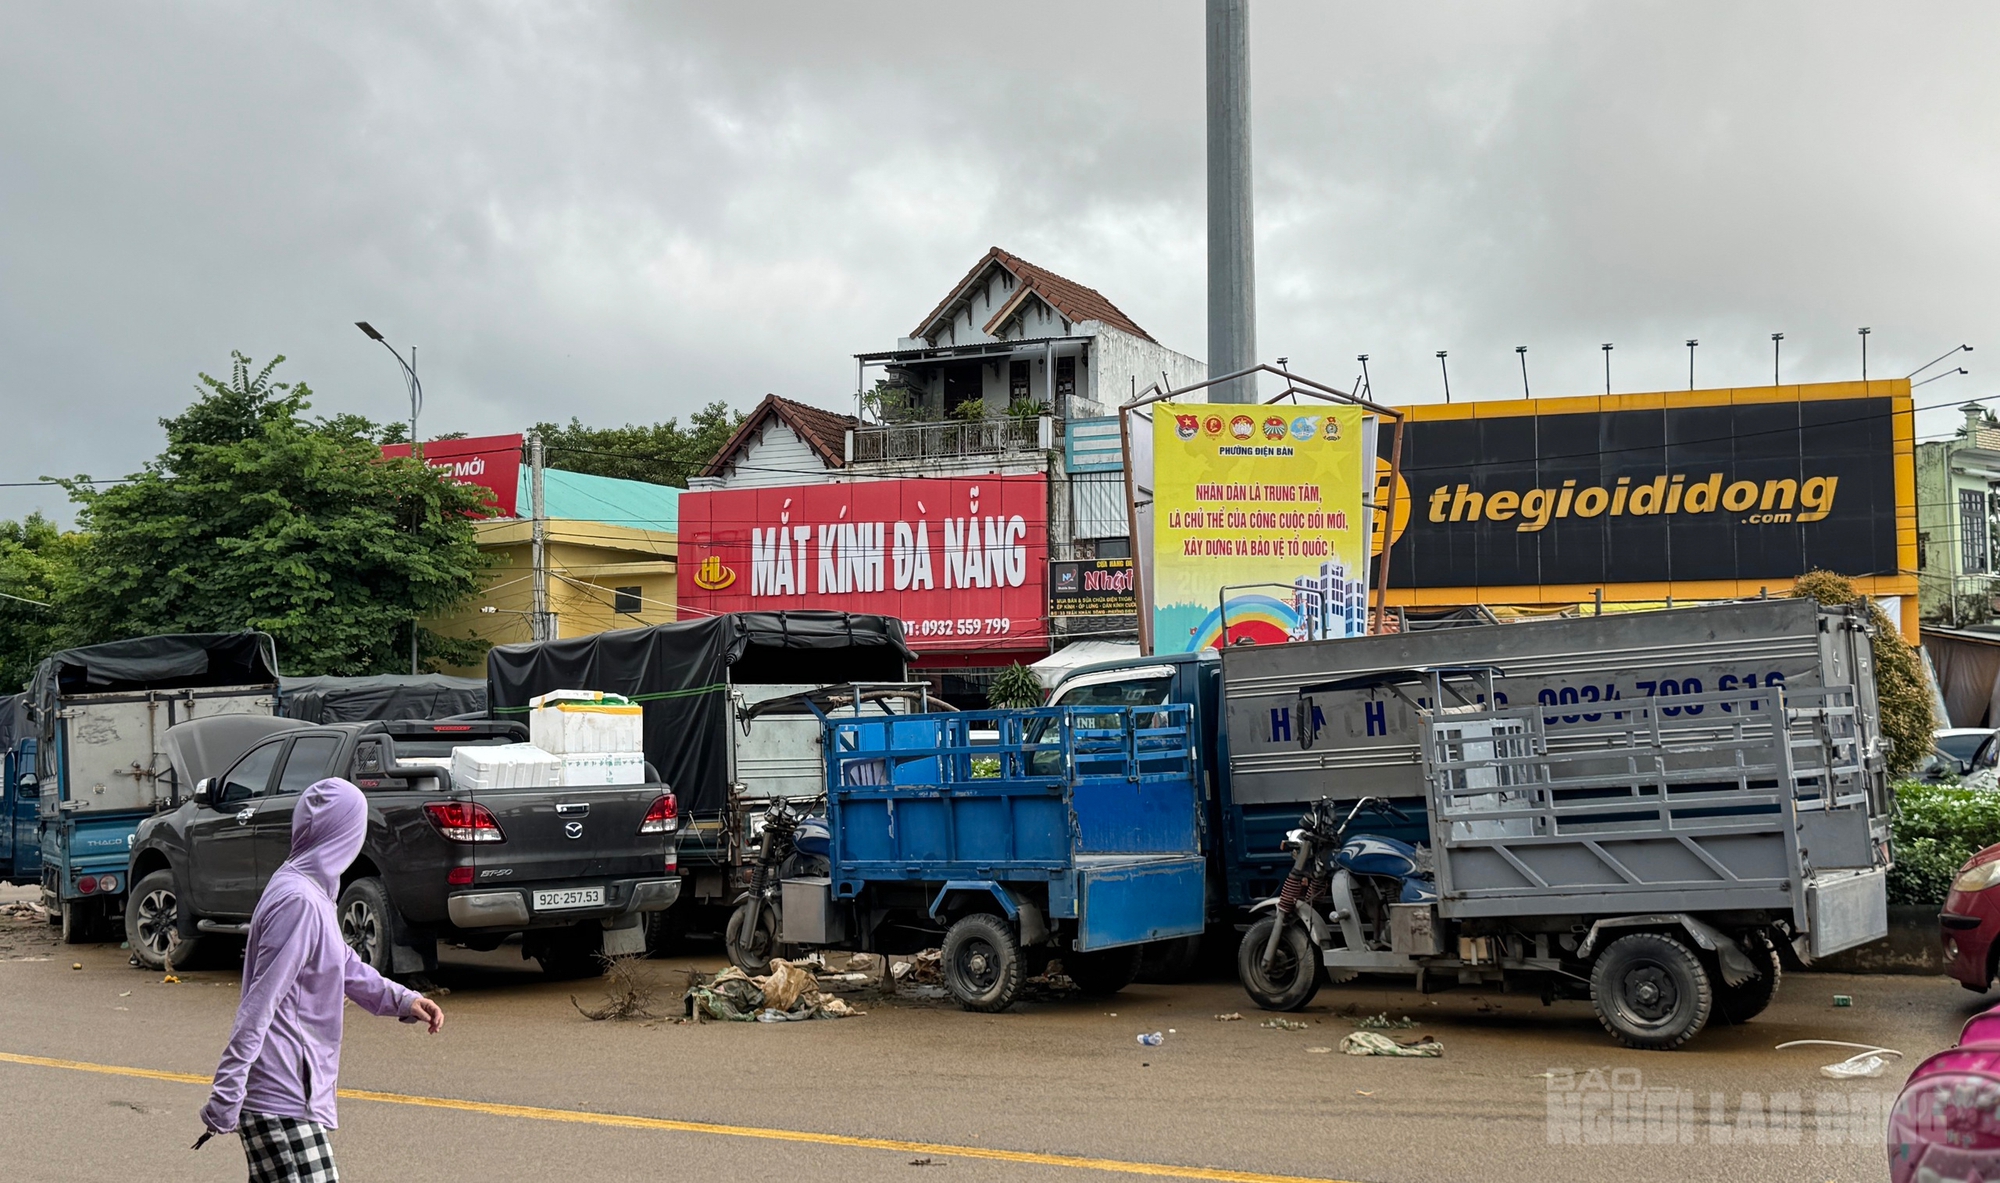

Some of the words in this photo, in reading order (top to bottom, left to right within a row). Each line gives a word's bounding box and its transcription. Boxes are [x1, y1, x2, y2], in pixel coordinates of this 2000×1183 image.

[1219, 445, 1253, 456] PHƯỜNG
[1255, 446, 1274, 457] ĐIỆN
[455, 456, 485, 477] MỚI
[1196, 482, 1224, 501] NHÂN
[1226, 482, 1247, 501] DÂN
[1249, 482, 1261, 501] LÀ
[1264, 484, 1296, 502] TRUNG
[1298, 483, 1323, 503] TÂM,
[1428, 473, 1838, 532] thegioididong
[1169, 509, 1181, 528] LÀ
[1184, 507, 1204, 528] CHỦ
[1206, 506, 1225, 528] THỂ
[1227, 507, 1247, 529] CỦA
[1249, 509, 1276, 529] CÔNG
[1279, 509, 1305, 532] CUỘC
[1307, 506, 1324, 529] ĐỔI
[1326, 509, 1349, 531] MỚI,
[1741, 513, 1792, 525] .com
[751, 498, 811, 597] MẮT
[817, 505, 885, 594] KÍNH
[891, 500, 934, 591] ĐÀ
[944, 485, 1027, 590] NẴNG
[1184, 537, 1203, 556] XÂY
[1205, 539, 1233, 559] DỰNG
[1235, 537, 1248, 556] VÀ
[1250, 535, 1270, 556] BẢO
[1273, 537, 1285, 559] VỆ
[1287, 534, 1299, 556] TỔ
[1302, 535, 1328, 557] QUỐC
[1084, 568, 1133, 595] Nhật
[921, 619, 954, 636] 0932
[956, 618, 982, 636] 559
[984, 617, 1010, 635] 799
[87, 838, 123, 847] THACO
[539, 890, 599, 906] 92C-257.53
